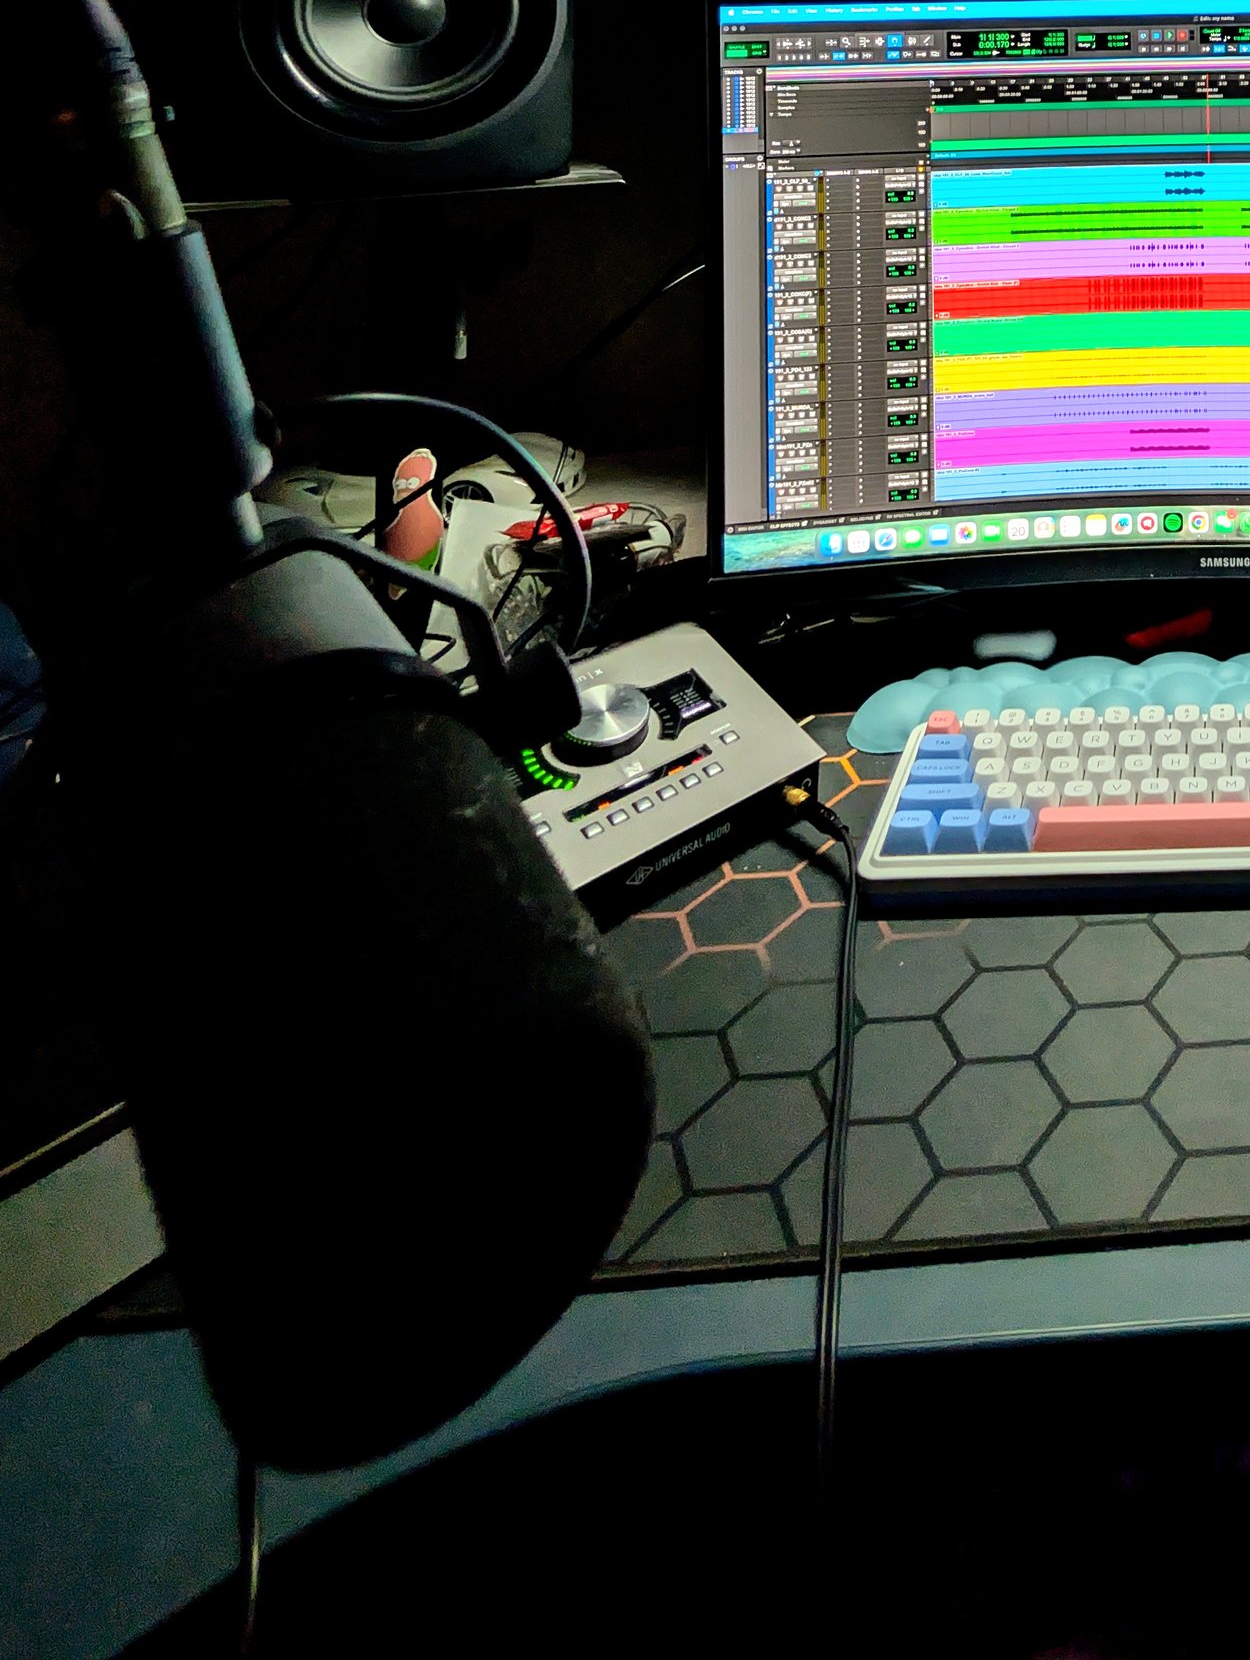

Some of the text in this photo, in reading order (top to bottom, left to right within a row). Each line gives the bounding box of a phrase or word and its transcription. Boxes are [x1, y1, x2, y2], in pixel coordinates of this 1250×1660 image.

[995, 33, 1010, 41] 300
[978, 40, 1010, 49] 0:00.170
[1011, 525, 1026, 537] 20
[1200, 557, 1250, 568] SAMSUNG
[982, 737, 993, 745] Q
[1055, 735, 1064, 743] E
[1128, 734, 1137, 742] T
[1199, 732, 1209, 740] U
[1022, 762, 1031, 770] S
[1059, 761, 1069, 769] D
[1097, 760, 1105, 768] F
[1133, 759, 1144, 767] G
[1171, 758, 1181, 766] H
[1149, 782, 1159, 790] B
[1188, 781, 1199, 789] N
[1225, 780, 1237, 788] M
[655, 821, 731, 872] UNIVERSAL AUDIO
